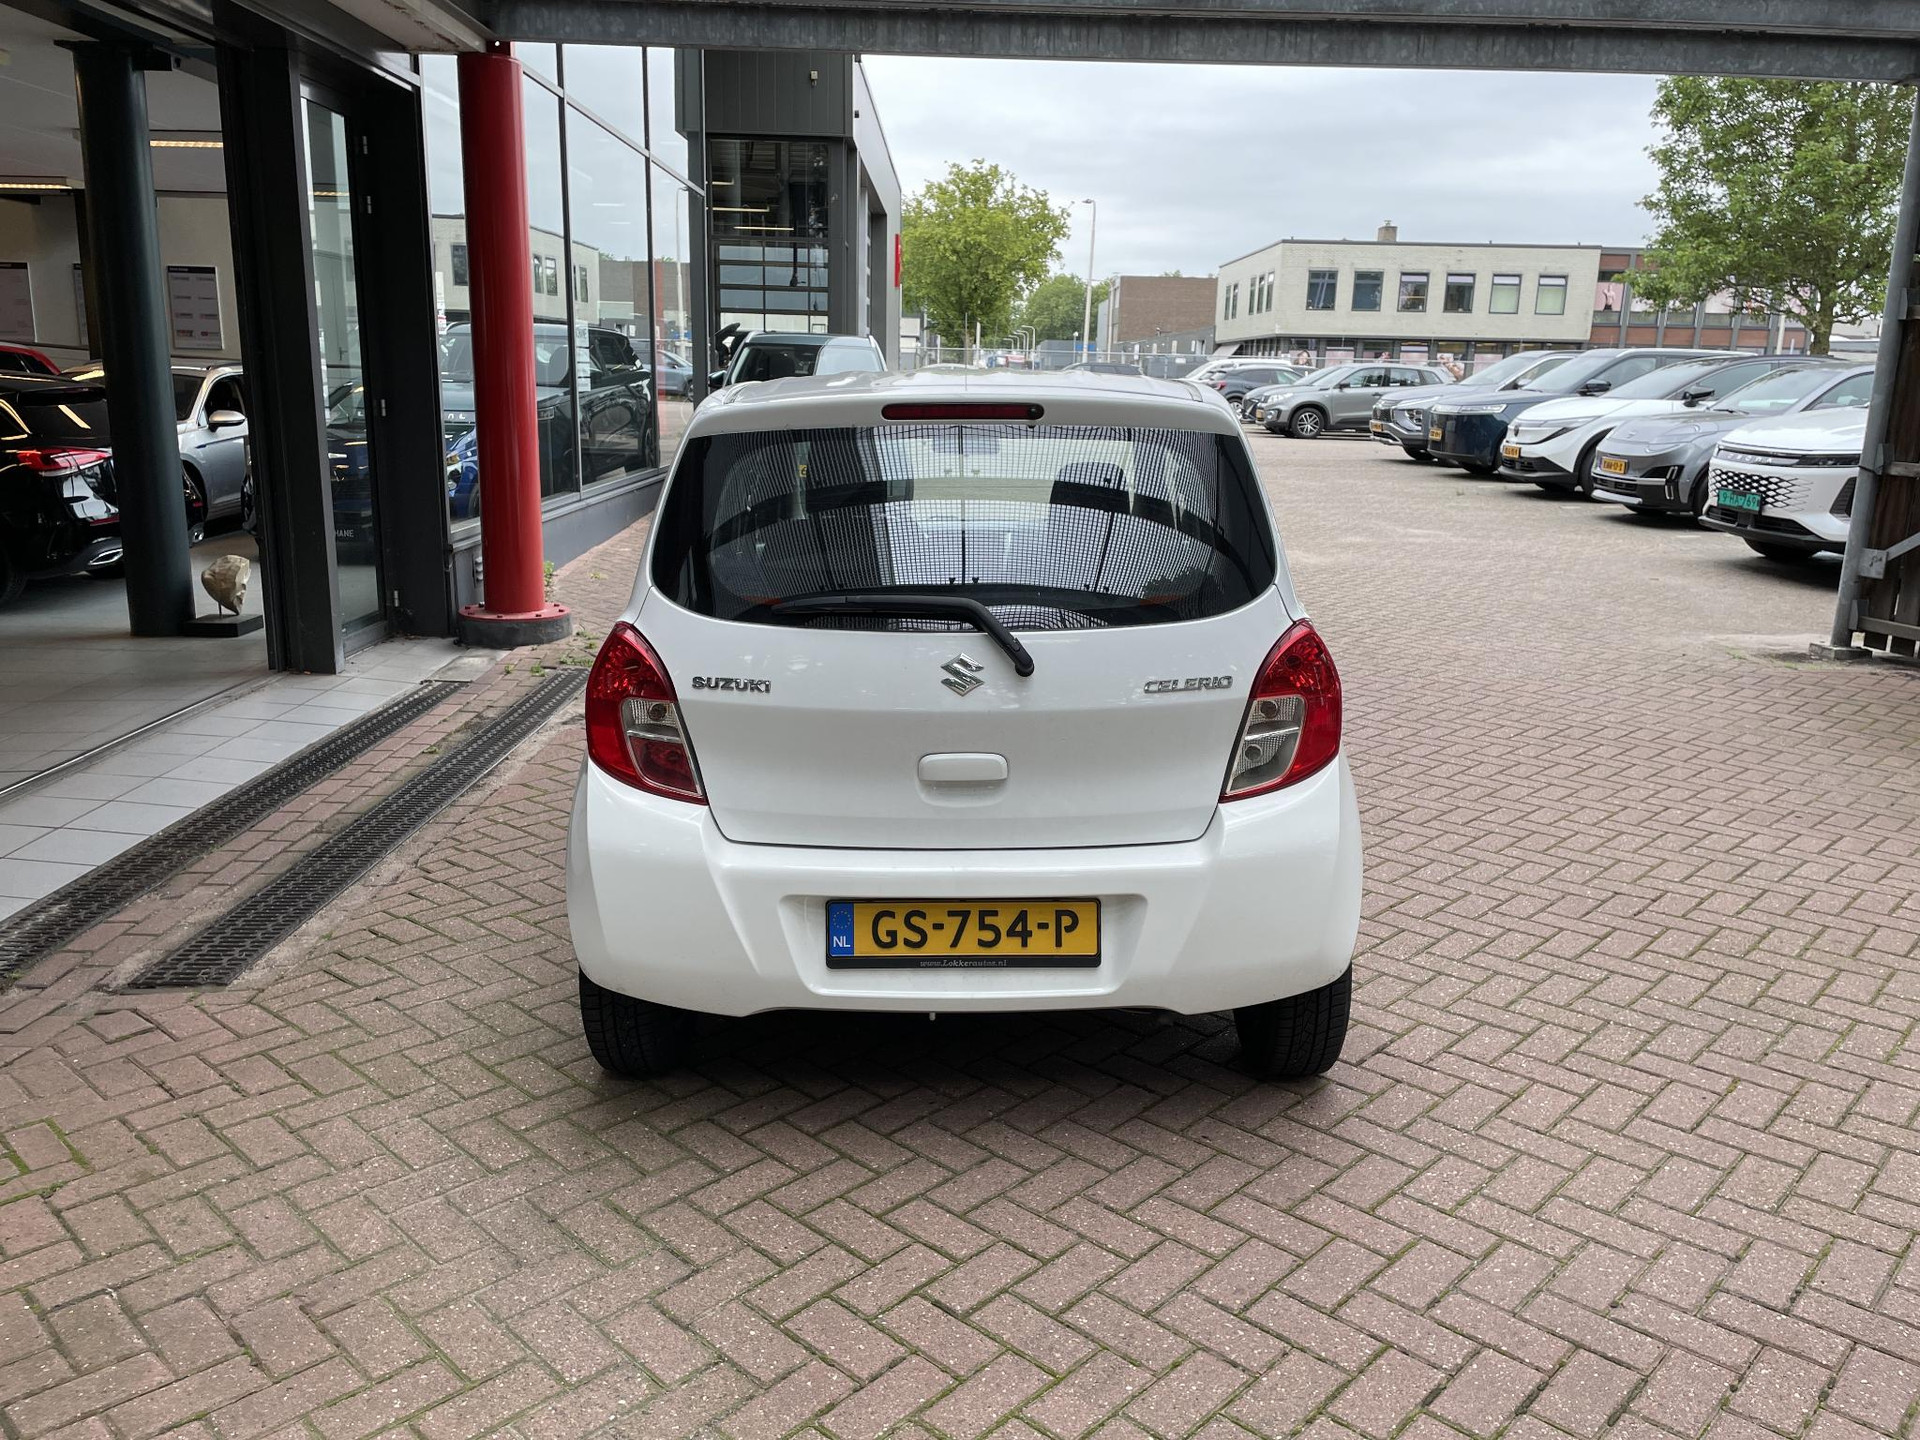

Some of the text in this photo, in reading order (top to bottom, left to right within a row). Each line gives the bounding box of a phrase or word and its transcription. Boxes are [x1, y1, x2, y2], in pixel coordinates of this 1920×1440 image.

[692, 676, 771, 693] SUZUKI
[1144, 675, 1233, 694] CELERIO
[833, 909, 1080, 949] NL GS-754-P
[920, 959, 1007, 968] www.Lokkerautos.nl
